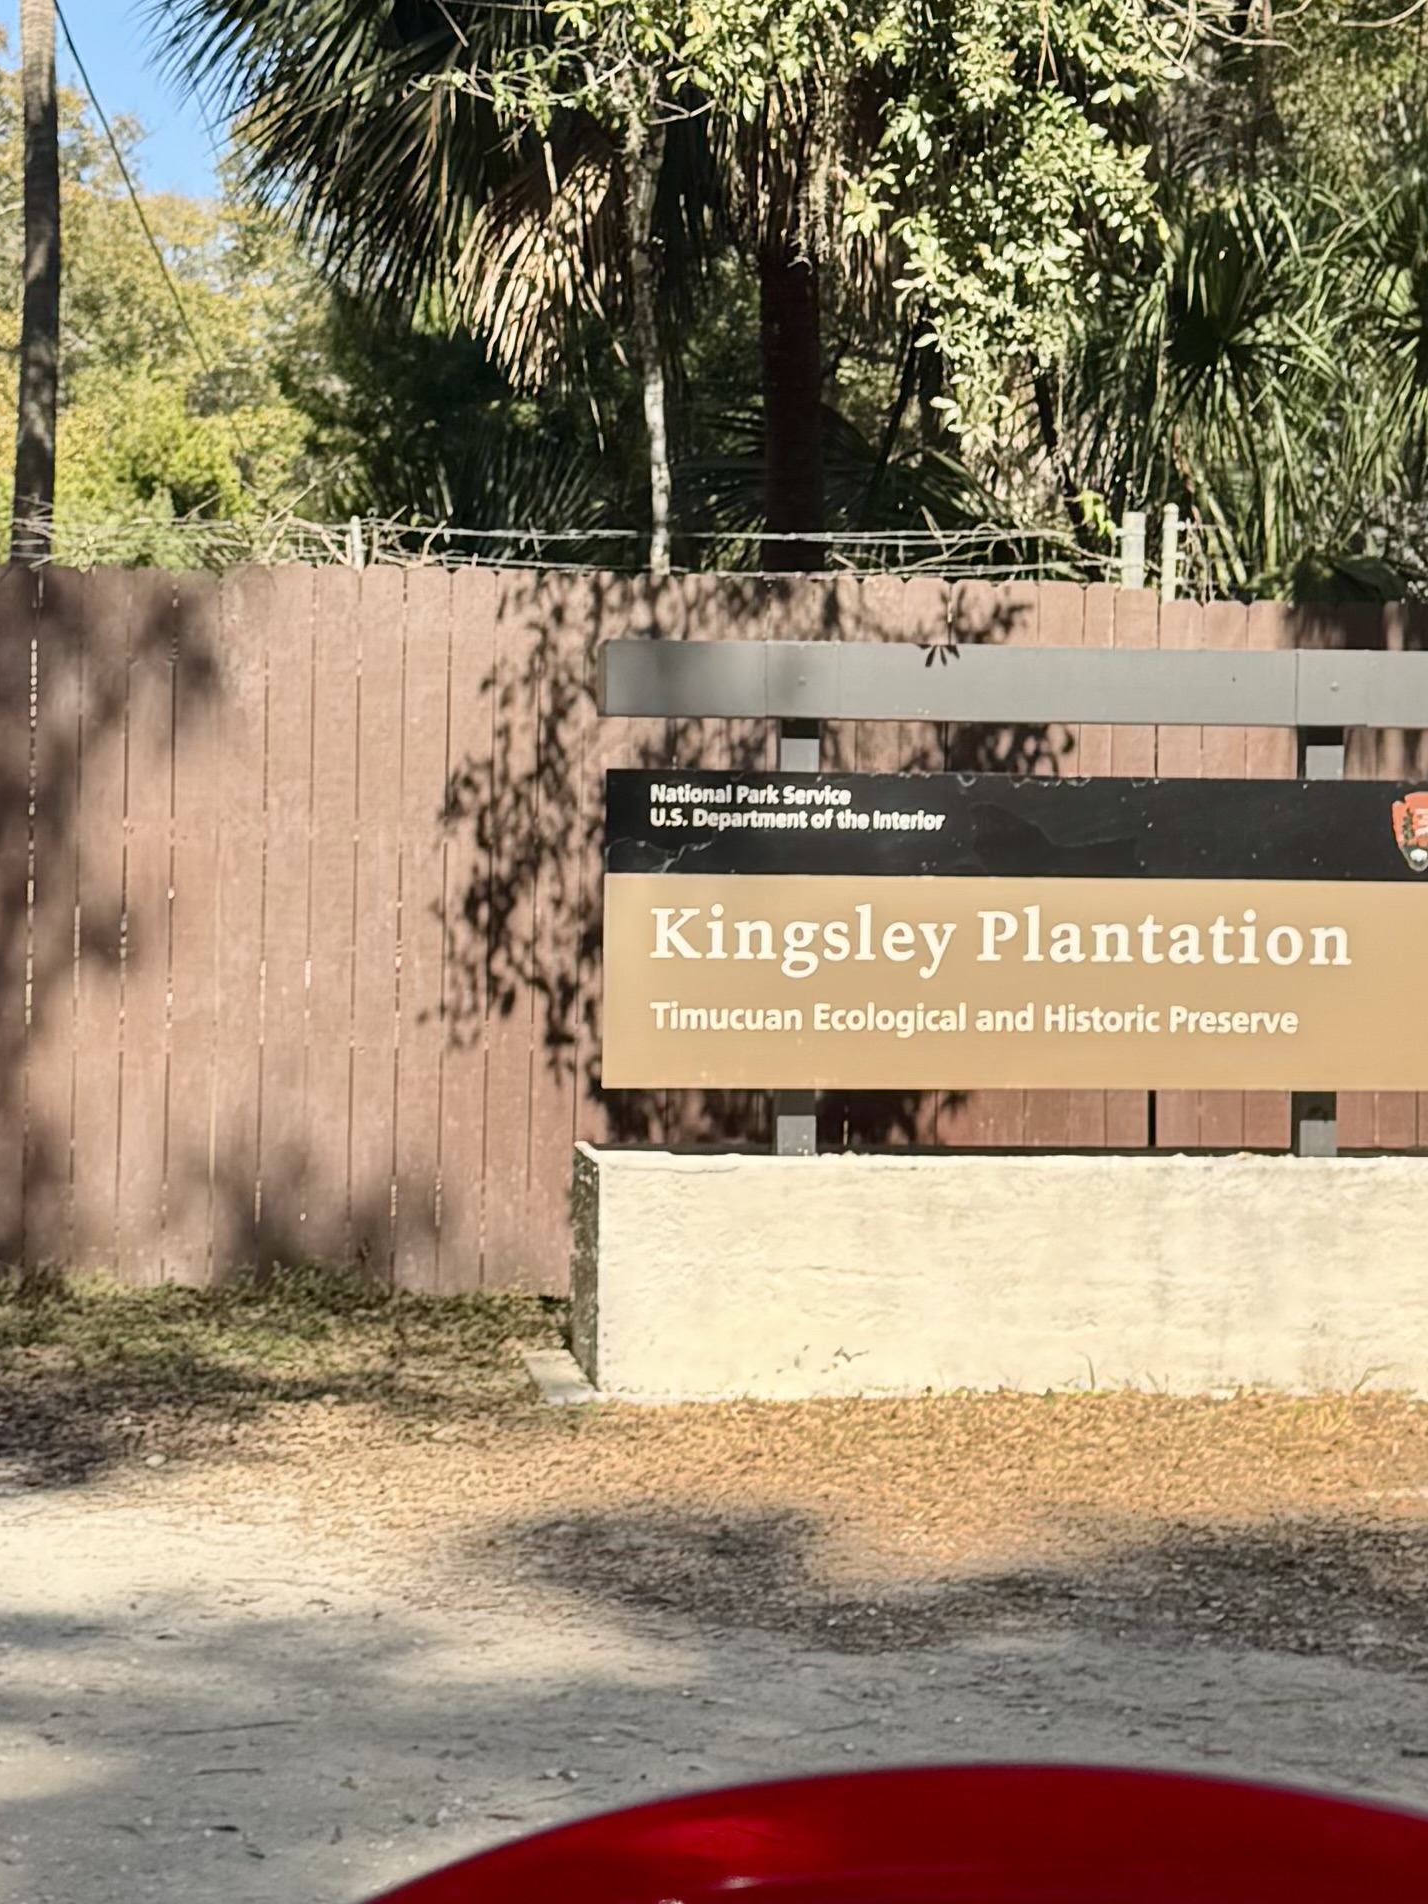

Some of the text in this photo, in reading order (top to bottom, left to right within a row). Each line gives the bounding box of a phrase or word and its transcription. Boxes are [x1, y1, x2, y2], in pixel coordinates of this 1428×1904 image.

[650, 784, 851, 806] National Park Service
[650, 807, 946, 832] U.S. Department of the Interior
[650, 903, 1352, 978] Kingsley Plantation
[650, 1001, 1299, 1038] Timucuan Ecological and Historic Preserve
